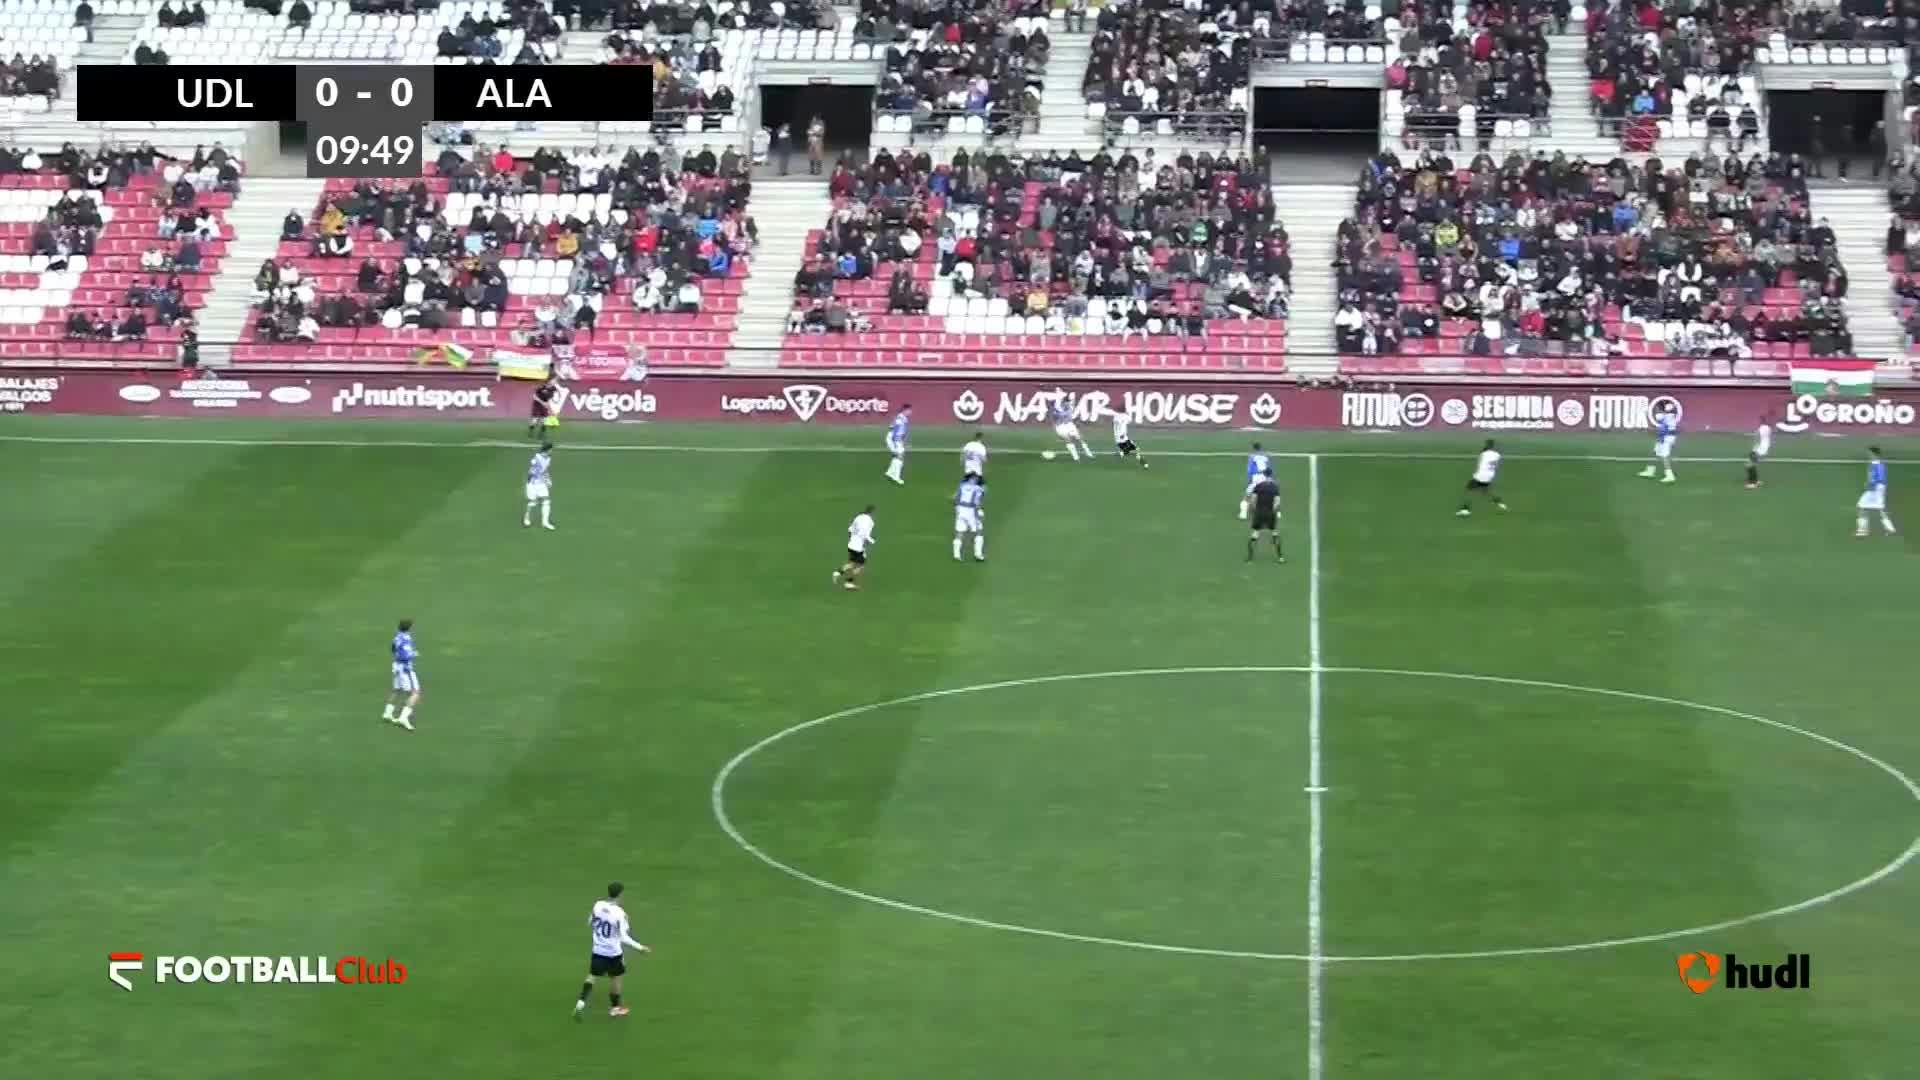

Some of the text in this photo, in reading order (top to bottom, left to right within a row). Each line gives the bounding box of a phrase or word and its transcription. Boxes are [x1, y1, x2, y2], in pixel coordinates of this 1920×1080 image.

[365, 385, 492, 410] nutrisport
[721, 394, 787, 413] Logroño
[825, 396, 889, 413] Deporte
[1472, 395, 1554, 419] SEGUNDA
[1786, 394, 1915, 425] LOGROÑO
[592, 916, 612, 938] 20
